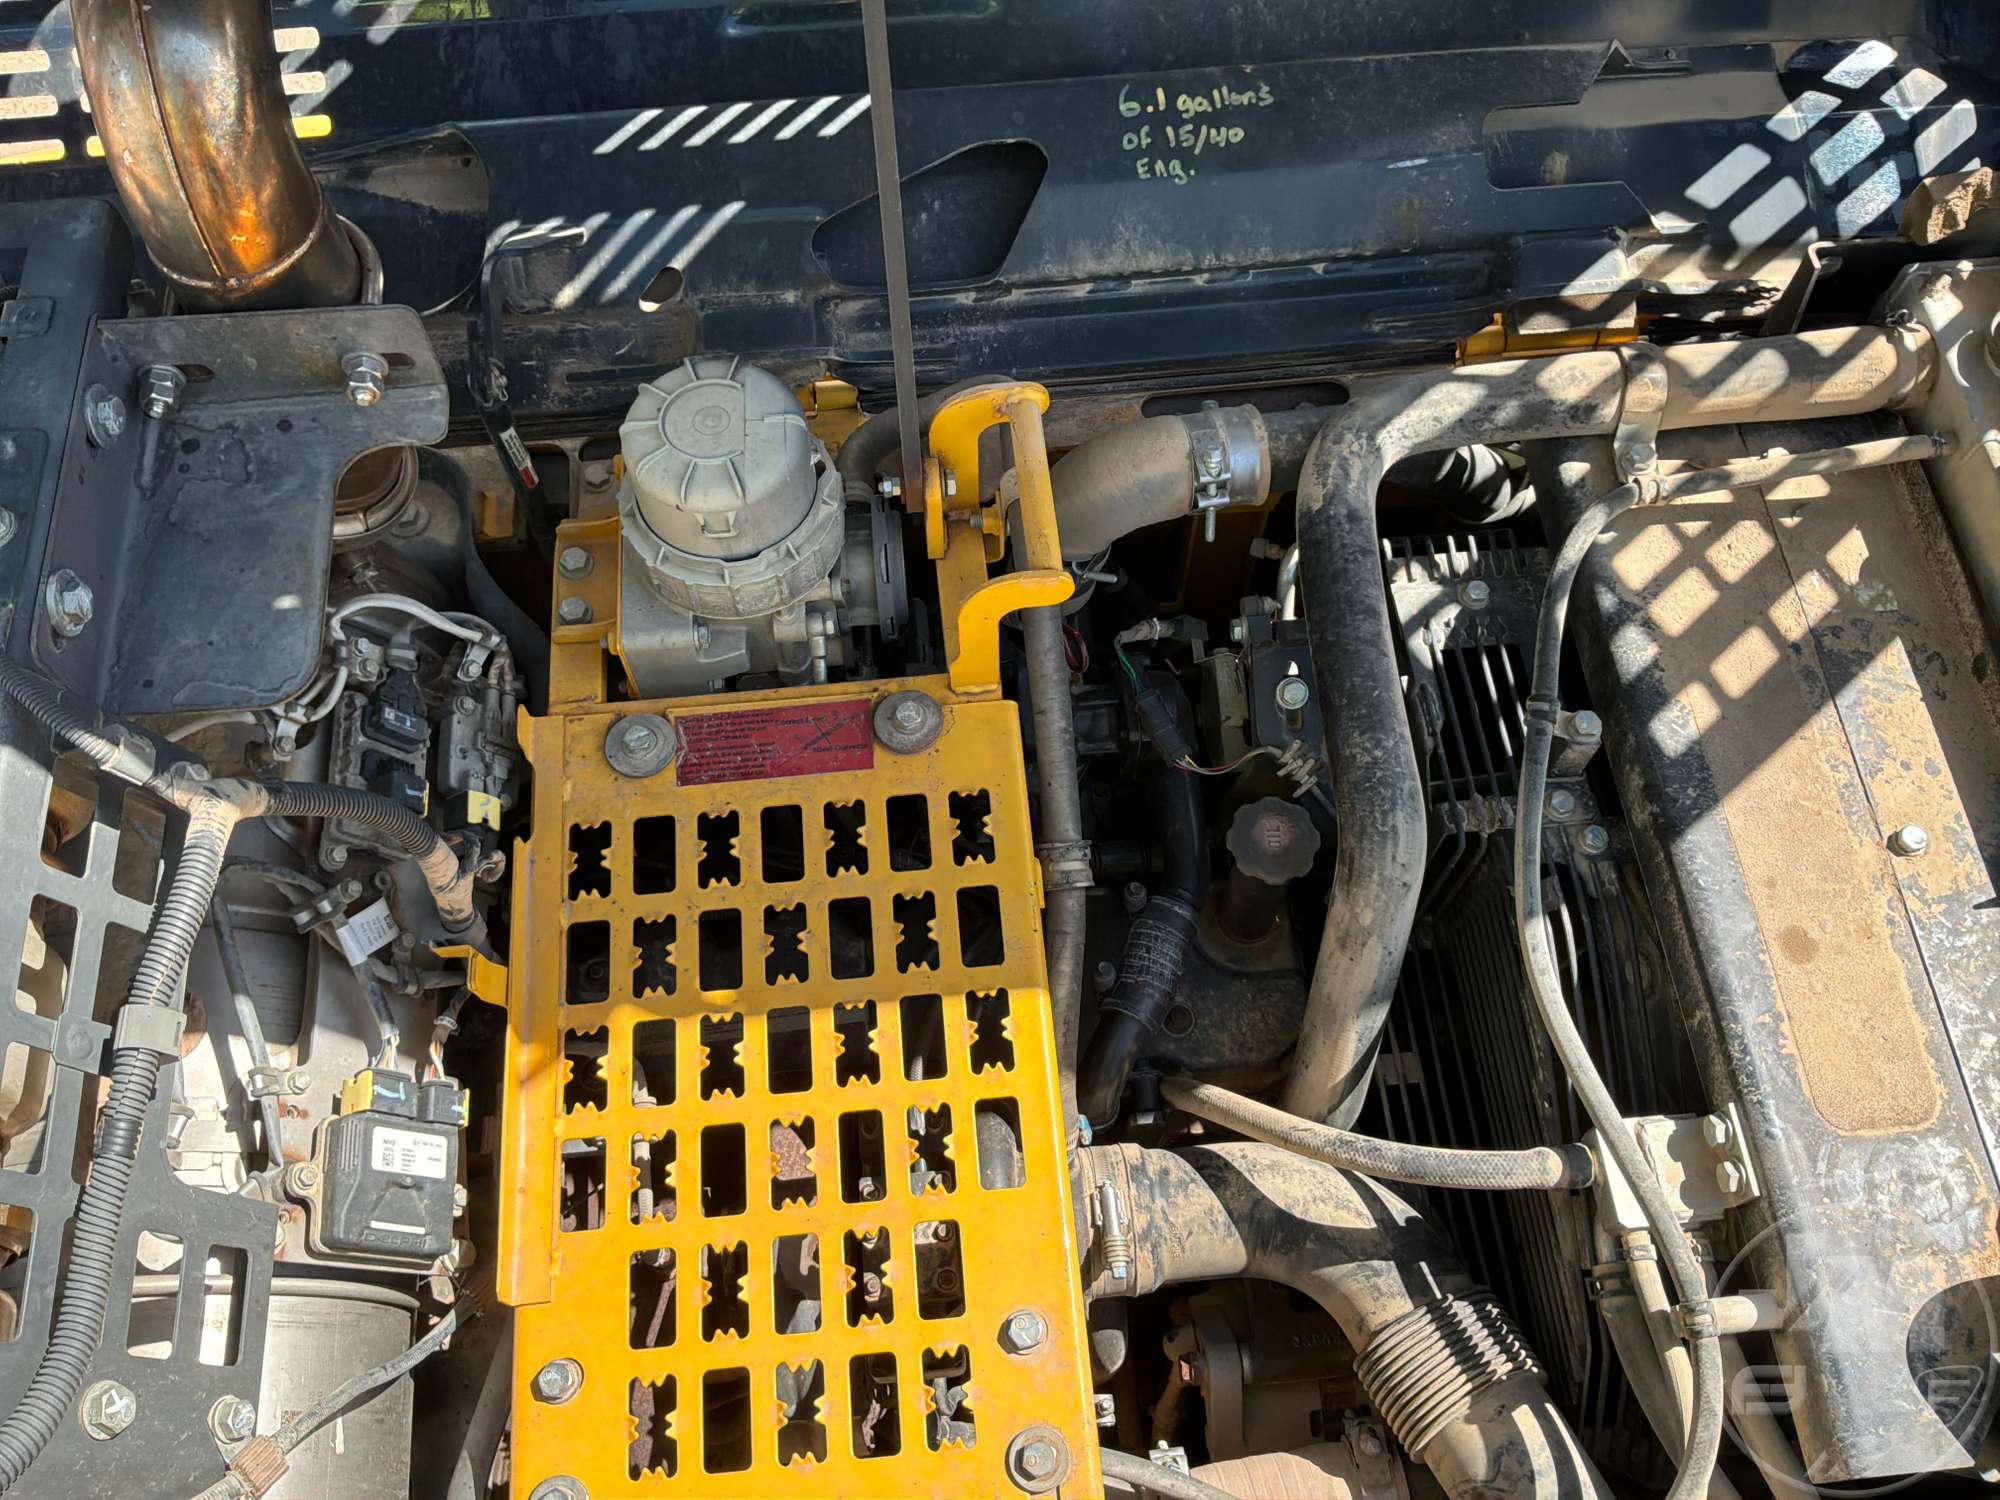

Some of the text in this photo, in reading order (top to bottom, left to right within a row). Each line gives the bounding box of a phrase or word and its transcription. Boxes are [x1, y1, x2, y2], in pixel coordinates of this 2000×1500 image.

[1118, 82, 1275, 119] 6.1 gallons
[1165, 123, 1246, 155] 15/40
[1136, 157, 1195, 185] Eng.
